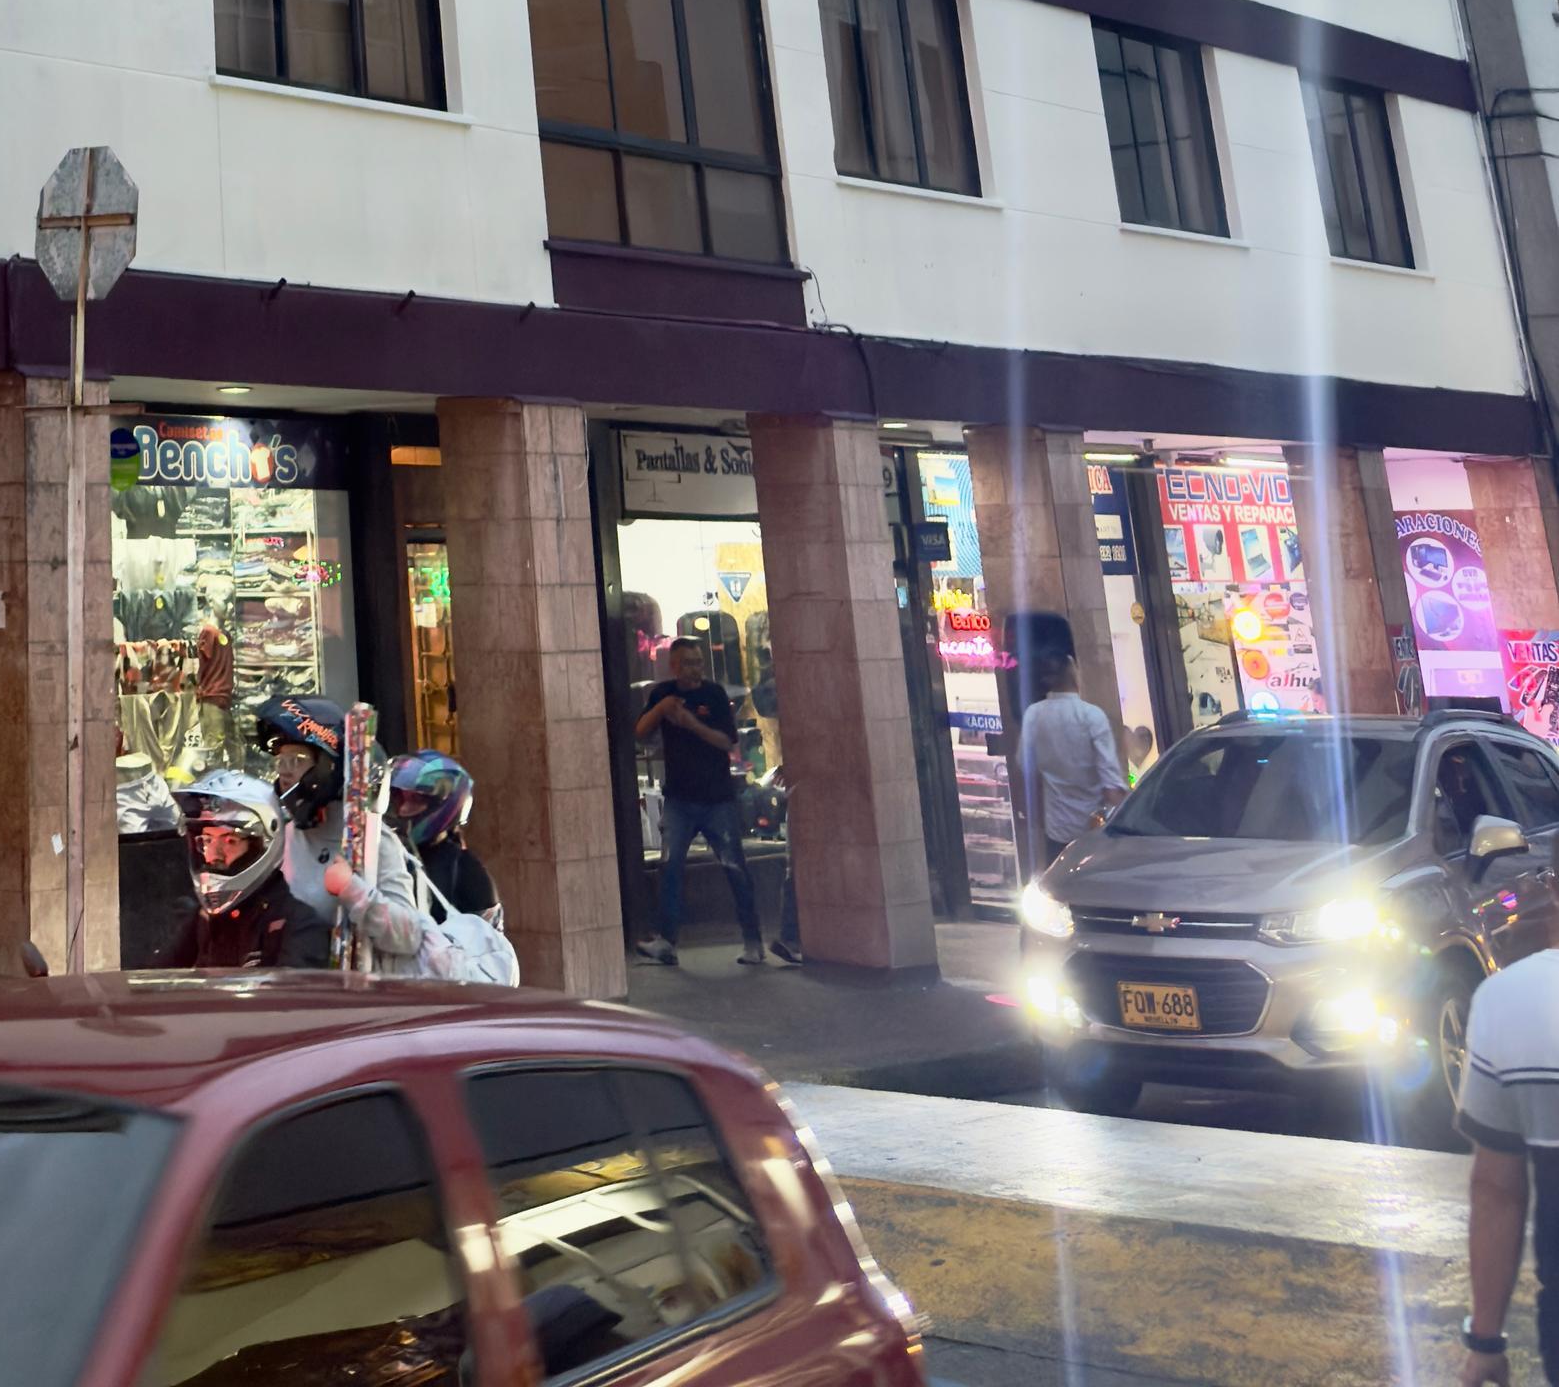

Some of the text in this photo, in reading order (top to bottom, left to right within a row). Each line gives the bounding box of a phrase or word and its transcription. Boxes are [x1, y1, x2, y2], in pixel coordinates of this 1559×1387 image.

[635, 445, 701, 474] Pantallas
[1168, 503, 1222, 523] VENTAS
[1222, 505, 1235, 524] Y
